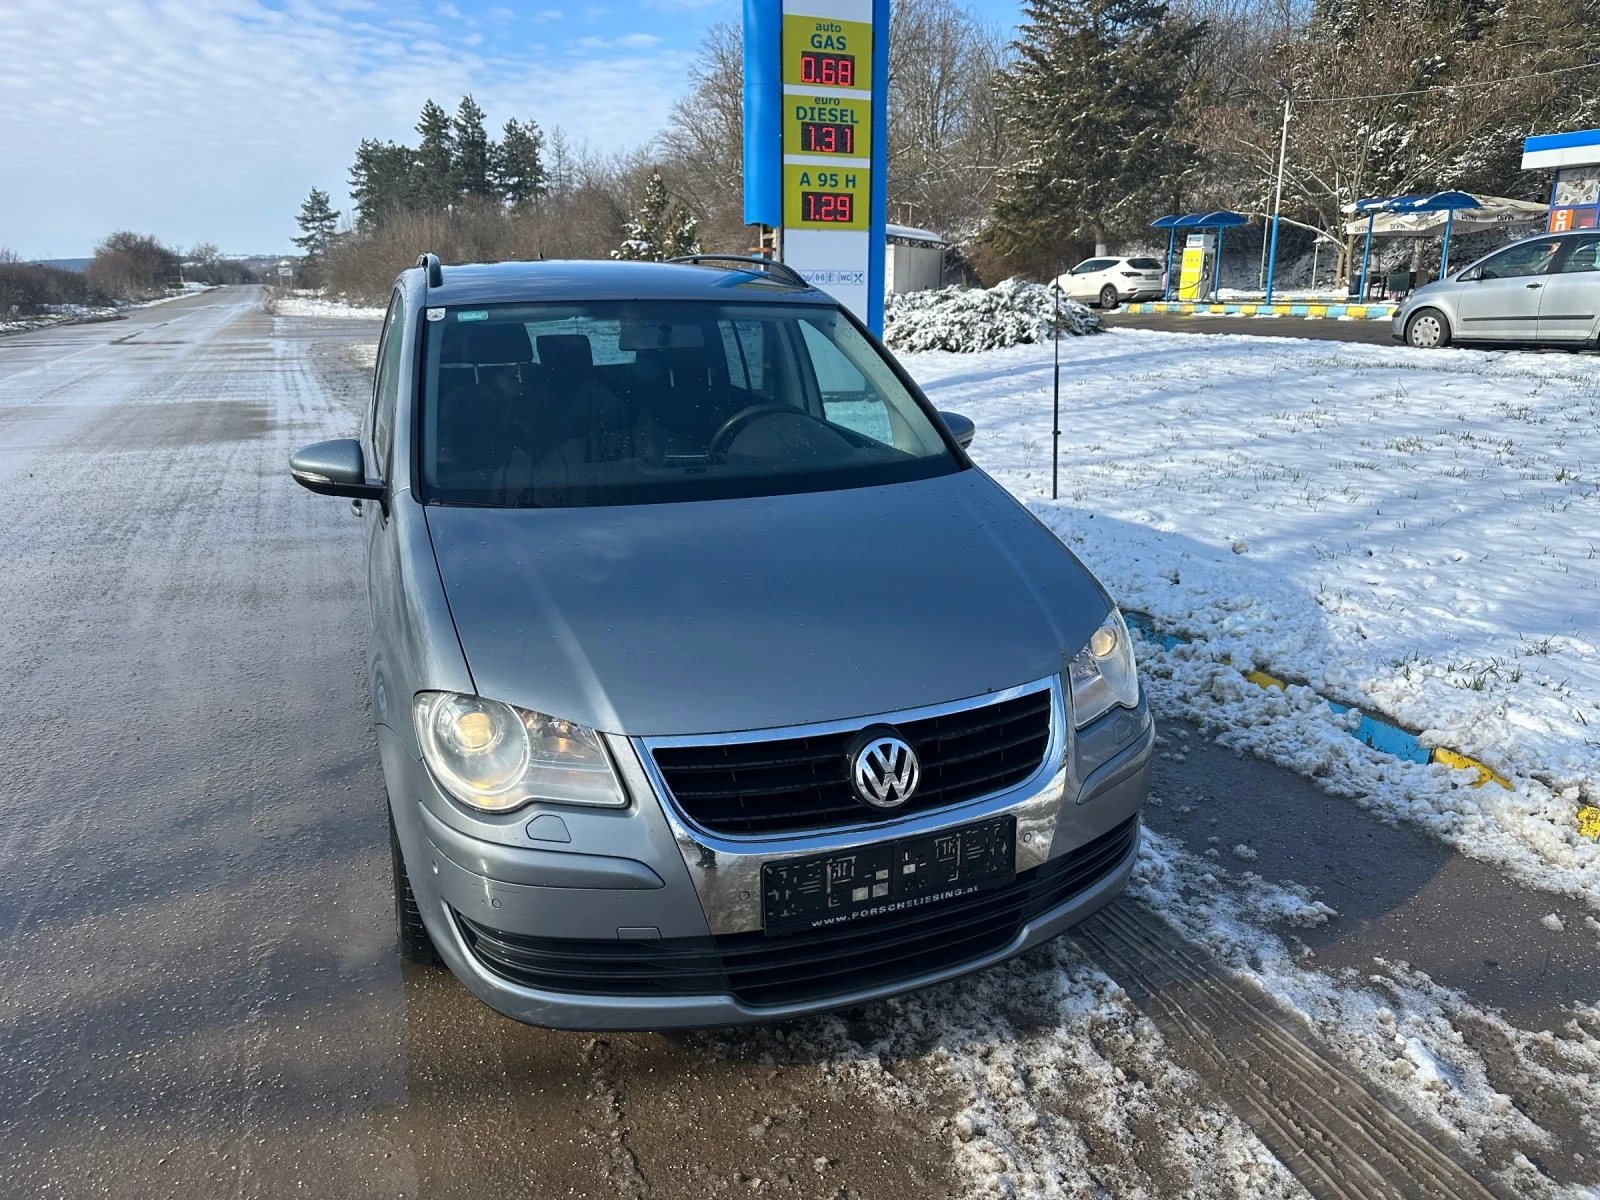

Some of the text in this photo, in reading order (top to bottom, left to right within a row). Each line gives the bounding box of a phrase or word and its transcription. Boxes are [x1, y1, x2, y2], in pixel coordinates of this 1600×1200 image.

[815, 22, 842, 33] auto
[810, 33, 847, 51] GAS
[801, 56, 852, 86] 0.68
[814, 96, 840, 106] euro
[795, 105, 859, 124] DIESEL
[808, 125, 852, 153] 1.31
[799, 172, 856, 188] A 95 H
[808, 195, 850, 221] 1.29
[840, 274, 851, 282] WC
